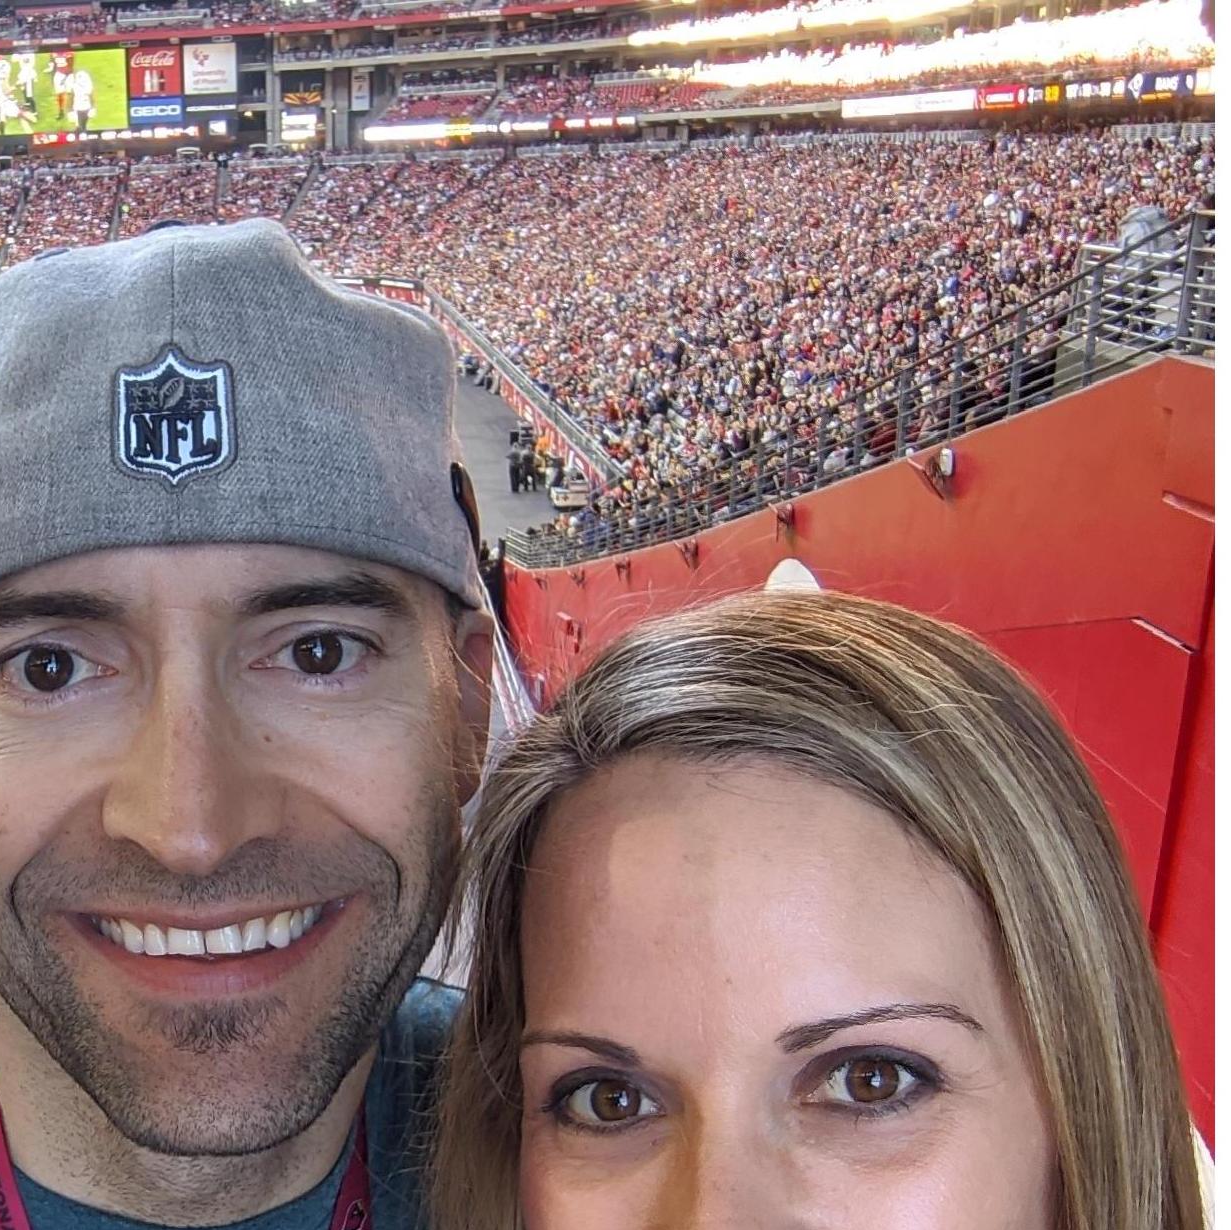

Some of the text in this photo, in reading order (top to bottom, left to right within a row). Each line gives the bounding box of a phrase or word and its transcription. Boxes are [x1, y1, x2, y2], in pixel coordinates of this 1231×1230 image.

[131, 50, 176, 68] Coca-Cola
[131, 105, 181, 117] GEICO
[132, 411, 219, 465] NFL
